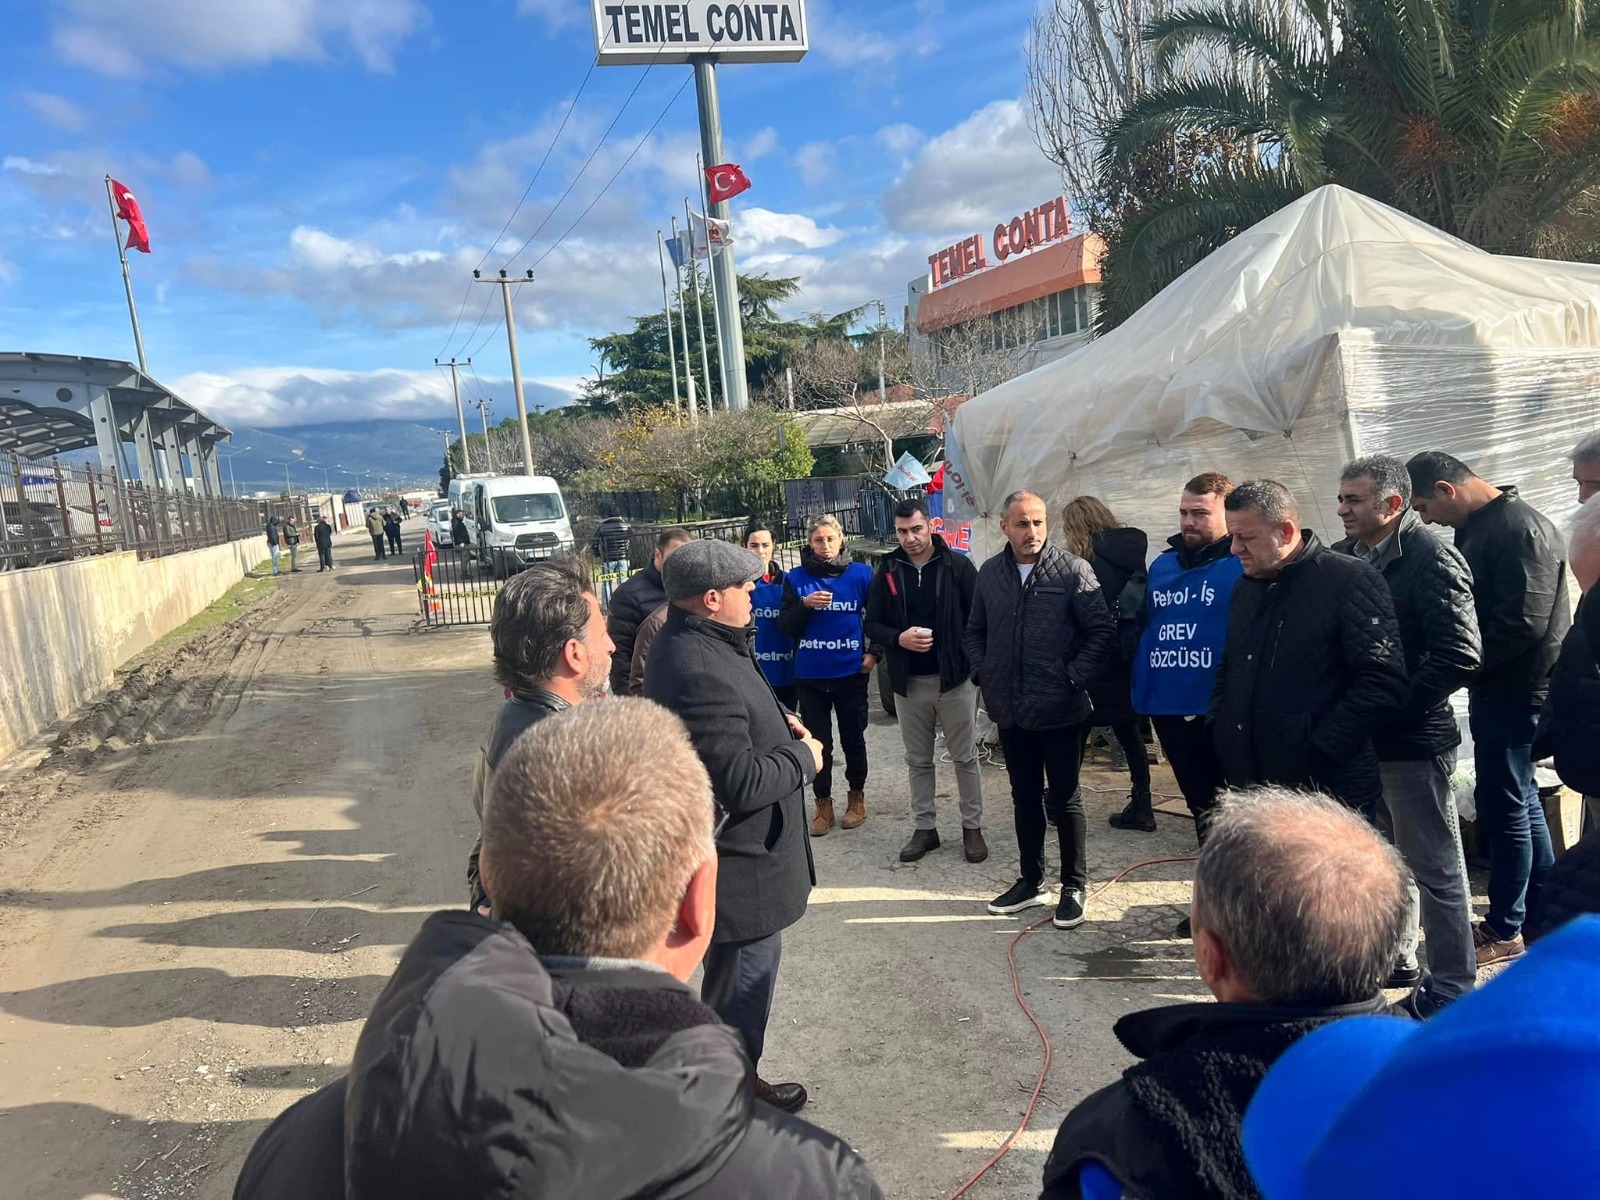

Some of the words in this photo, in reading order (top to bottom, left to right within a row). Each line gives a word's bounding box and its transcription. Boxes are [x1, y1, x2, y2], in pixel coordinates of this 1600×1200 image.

[605, 4, 700, 44] TEMEL
[706, 3, 798, 42] CONTA
[928, 232, 989, 288] TEMEL
[993, 192, 1072, 261] CONTA
[1152, 587, 1189, 608] Petrol
[1200, 580, 1215, 606] İş
[1158, 623, 1197, 641] GREV
[1149, 646, 1212, 669] GÖZCÜSÜ
